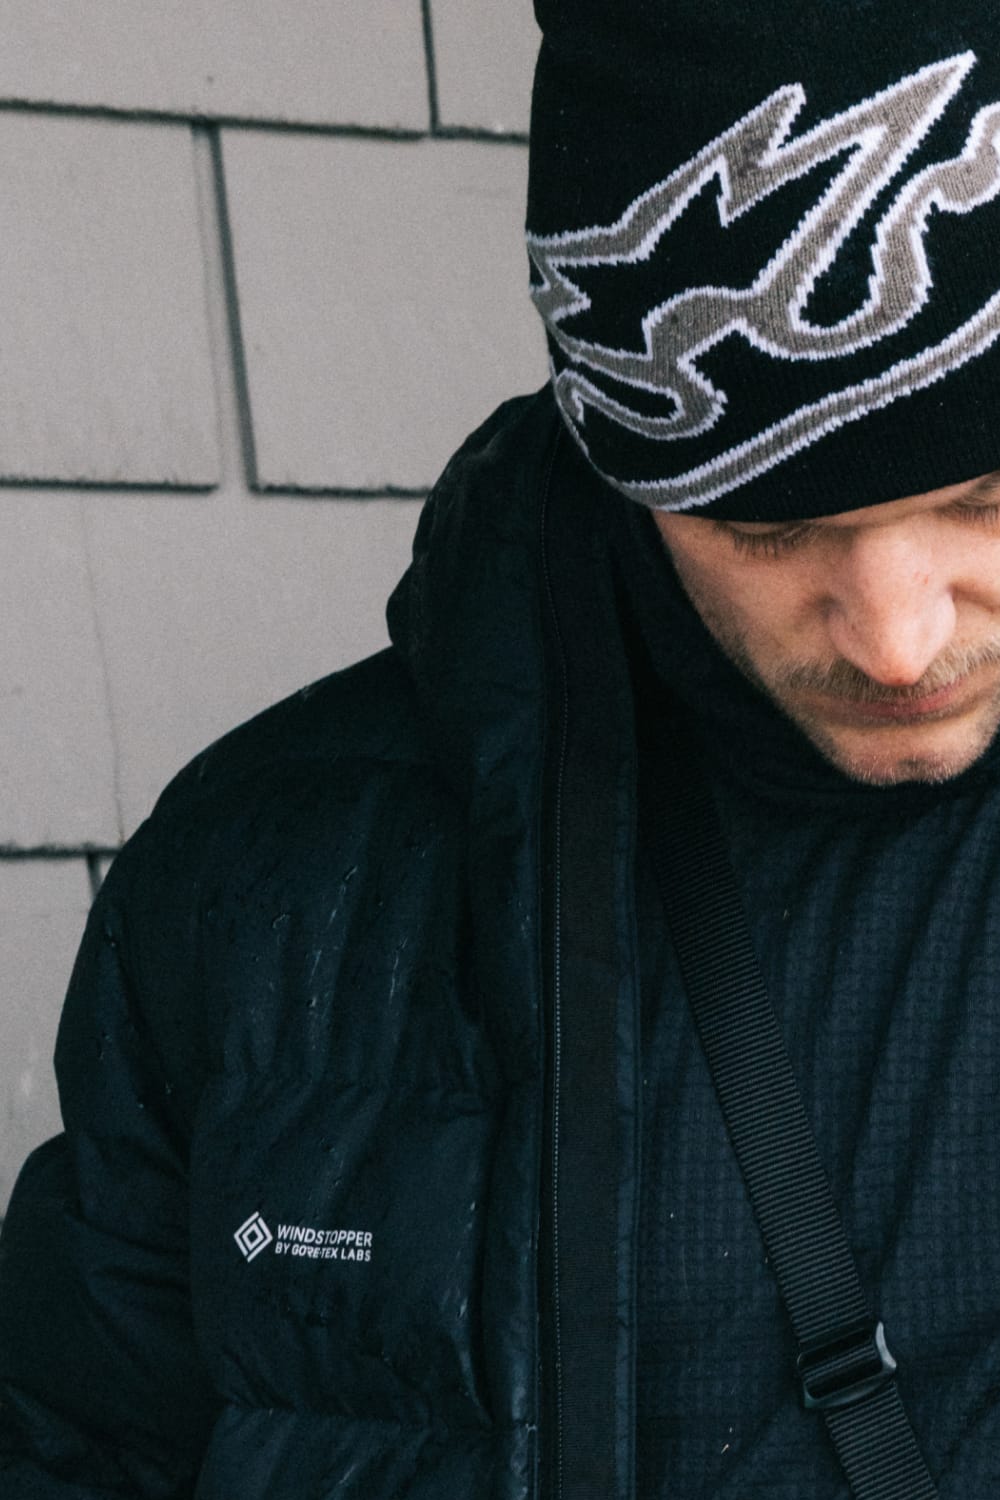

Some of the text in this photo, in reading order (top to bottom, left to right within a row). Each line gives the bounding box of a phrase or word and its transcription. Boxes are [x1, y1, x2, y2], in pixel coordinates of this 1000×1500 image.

[277, 1223, 373, 1247] WINDSTOPPER
[275, 1241, 371, 1262] BY GORE-TEX LABS
